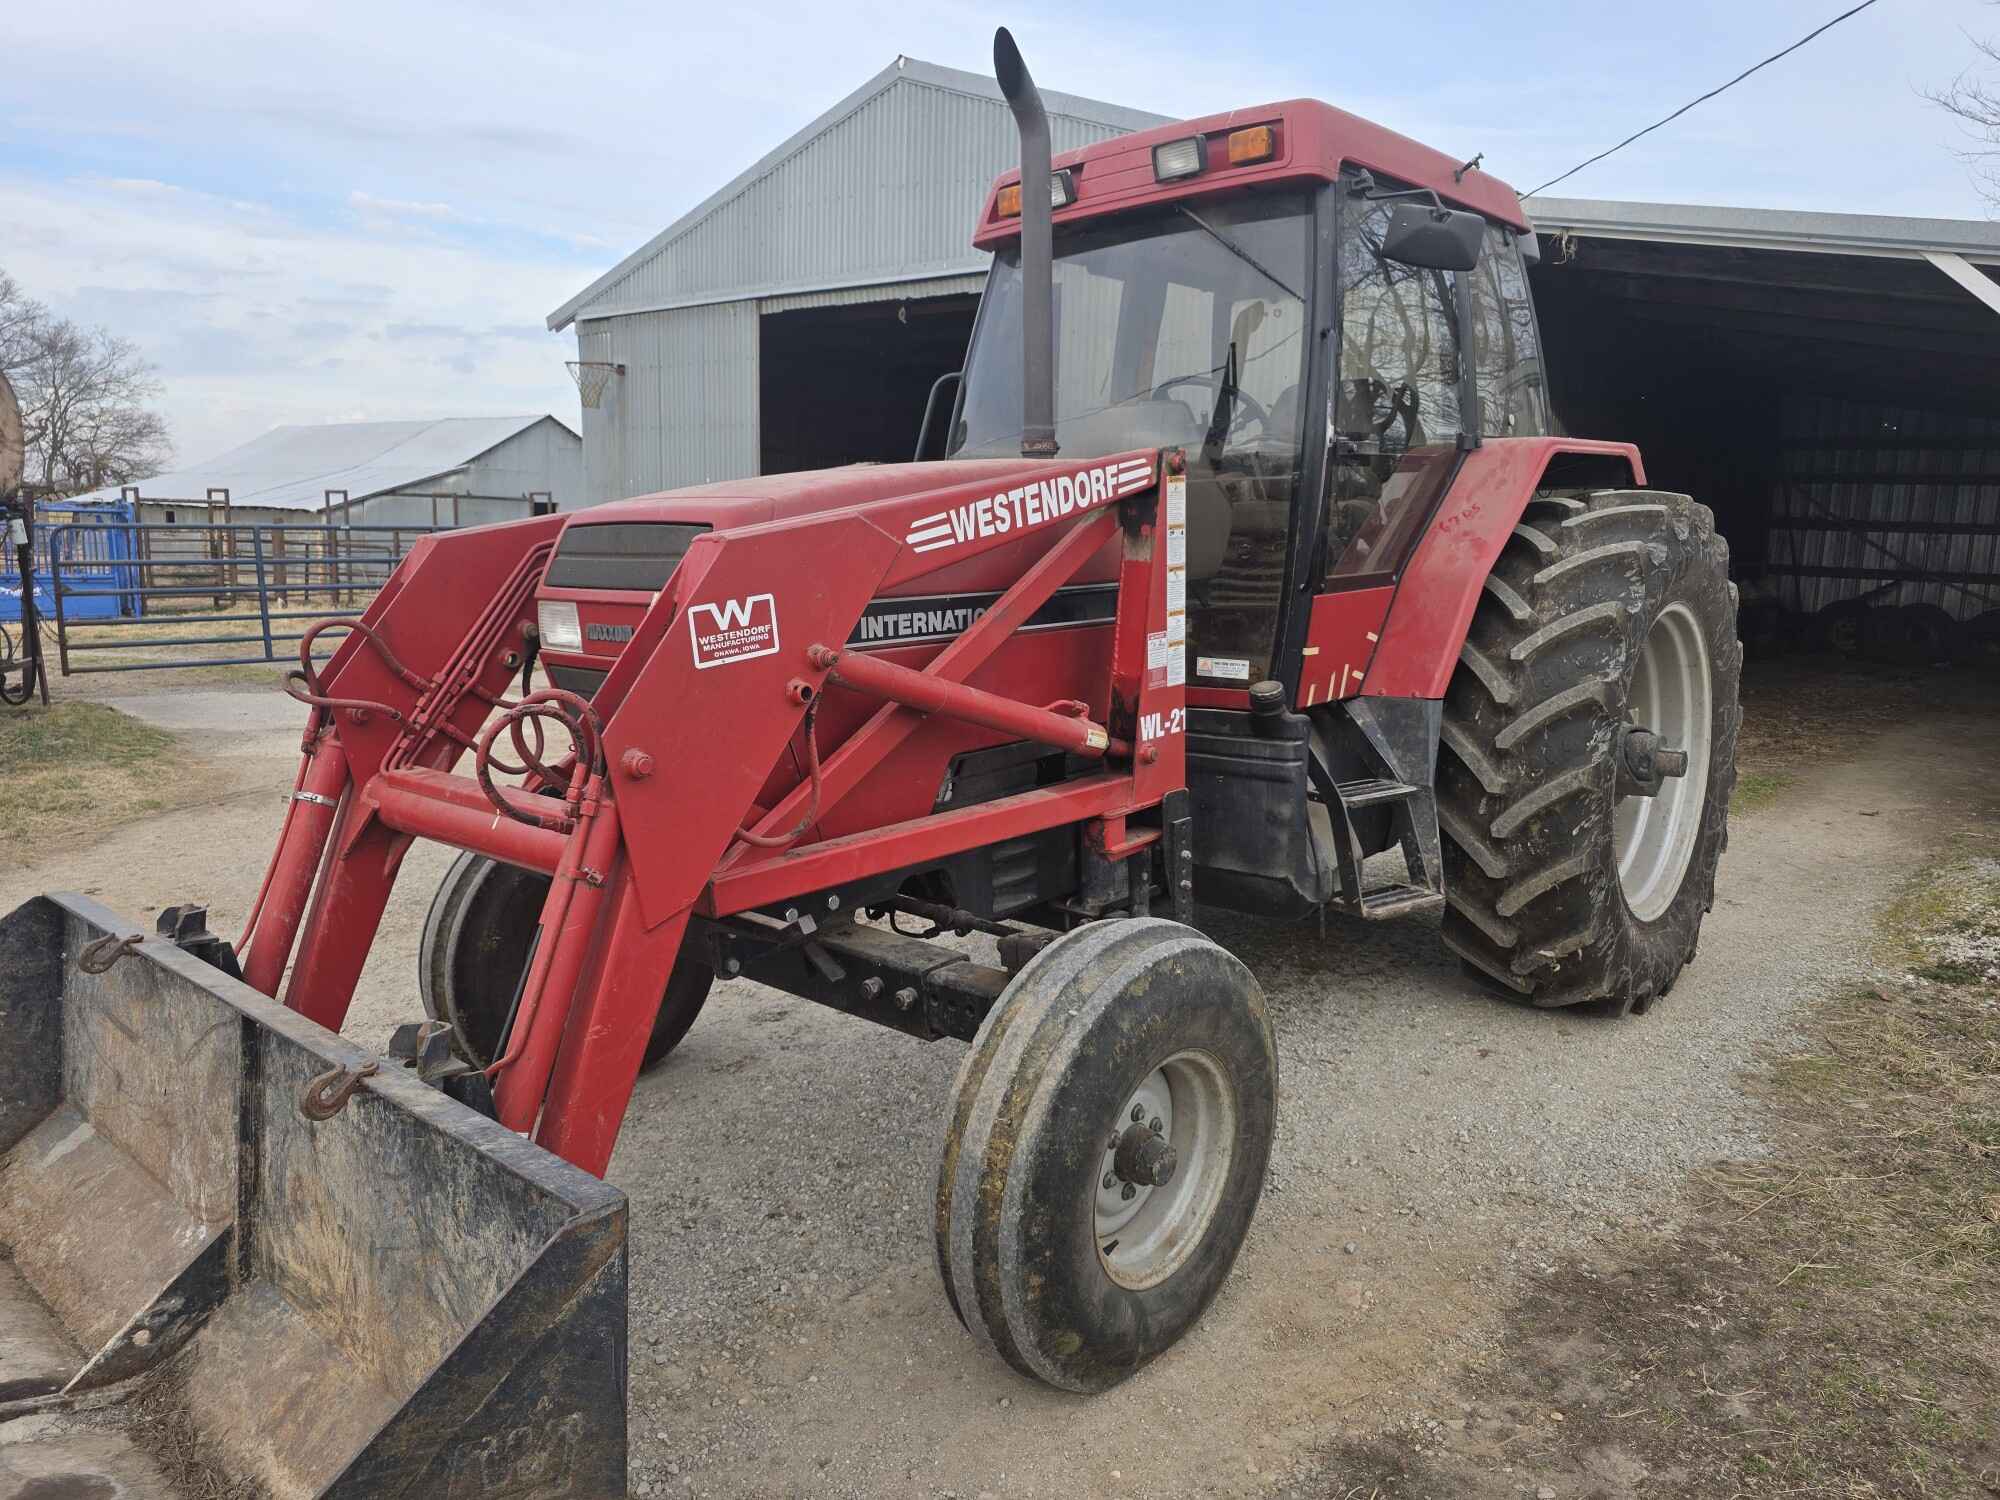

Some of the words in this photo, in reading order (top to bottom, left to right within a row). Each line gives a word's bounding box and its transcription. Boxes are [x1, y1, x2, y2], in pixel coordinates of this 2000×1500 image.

[950, 464, 1118, 543] WESTENDORF
[698, 624, 771, 645] WESTENDORF
[703, 633, 769, 652] MANUFACTURING
[714, 648, 742, 658] ONAWA,
[743, 643, 760, 652] IOWA
